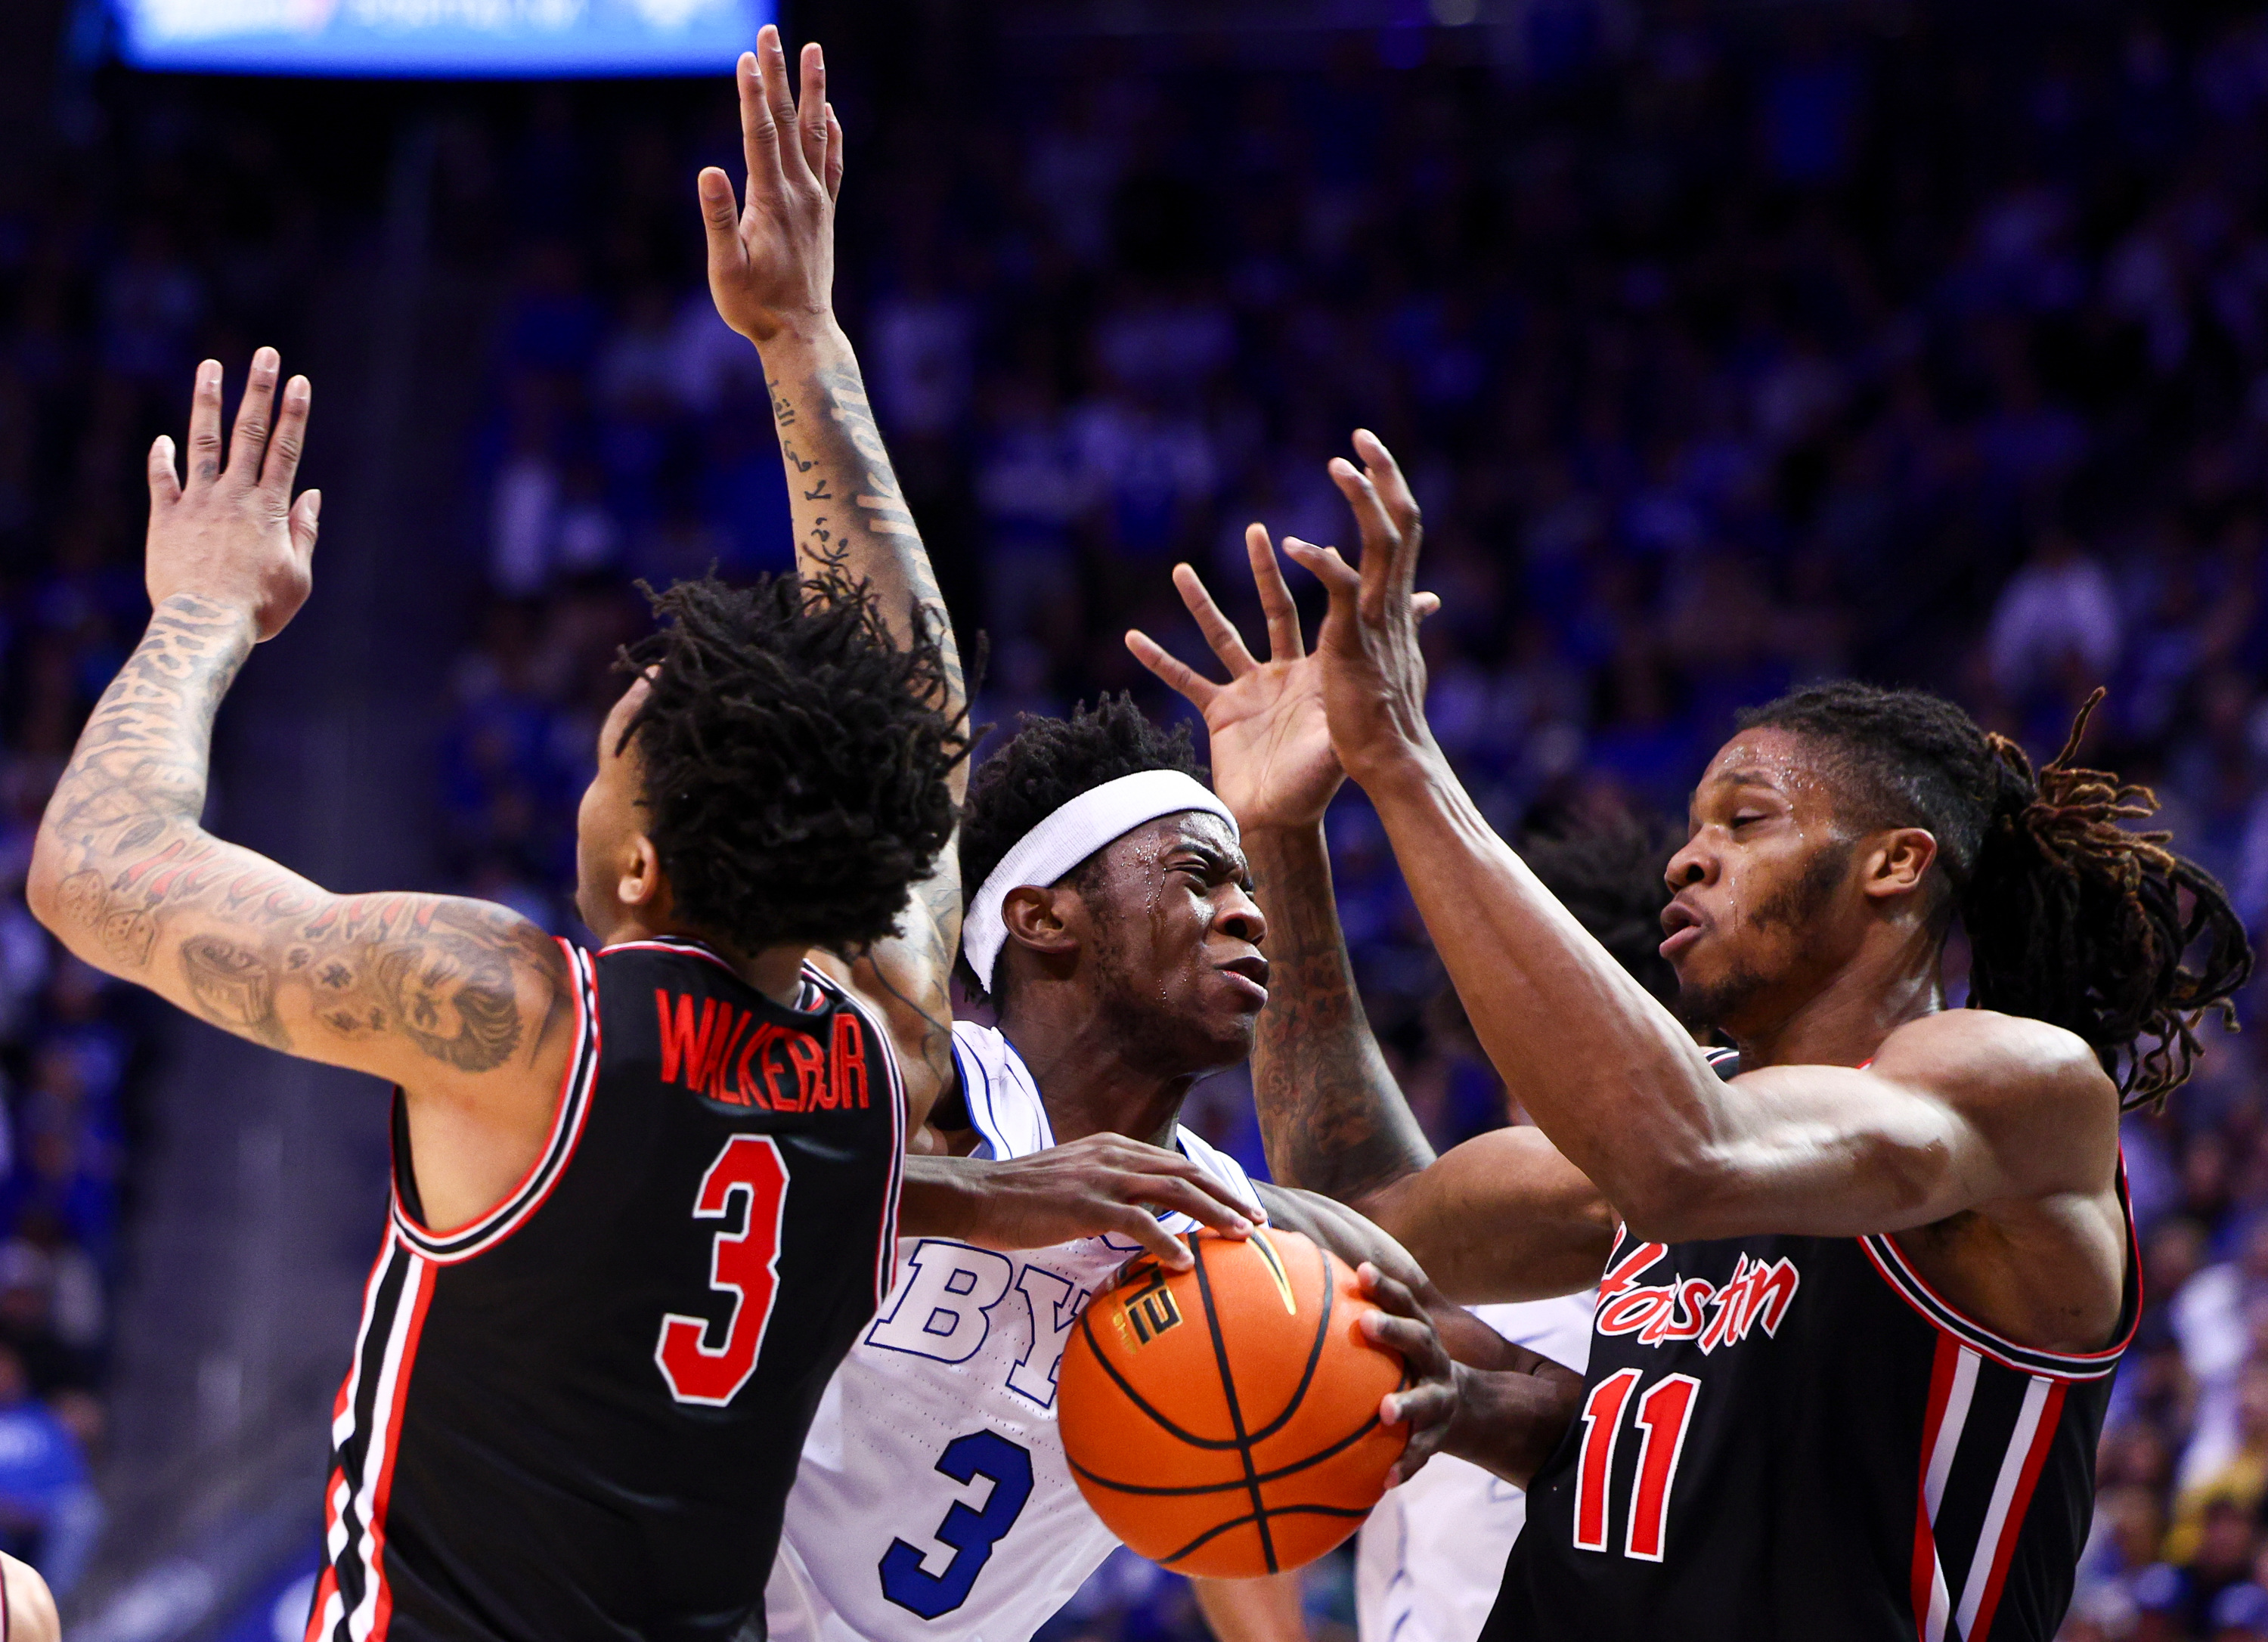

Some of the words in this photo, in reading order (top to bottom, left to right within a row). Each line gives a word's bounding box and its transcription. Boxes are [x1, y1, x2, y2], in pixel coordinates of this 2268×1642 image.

[655, 987, 825, 1114] WALKER
[654, 1133, 791, 1408] 3
[863, 1238, 1093, 1409] BY
[878, 1428, 1035, 1621] 3
[1573, 1367, 1702, 1563] 11
